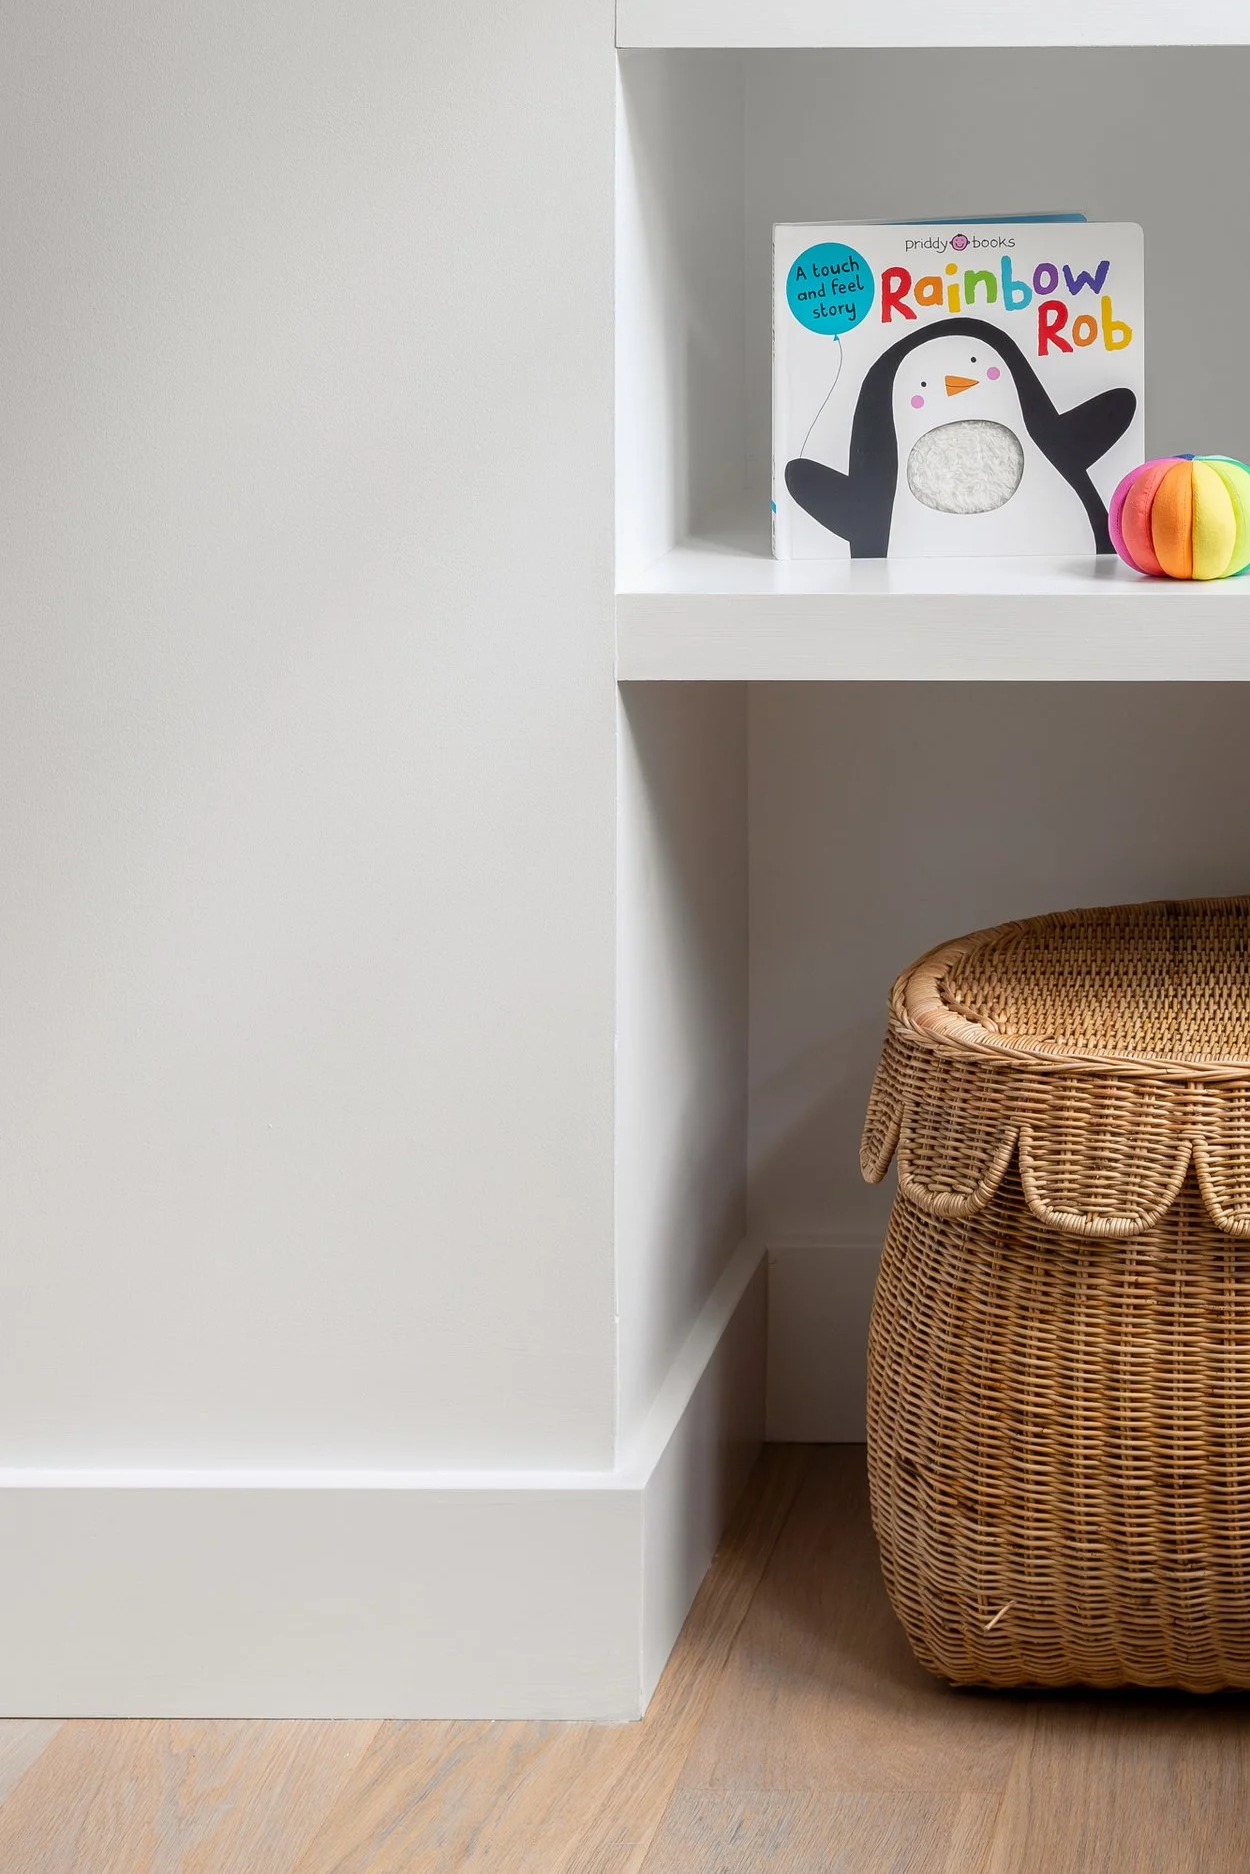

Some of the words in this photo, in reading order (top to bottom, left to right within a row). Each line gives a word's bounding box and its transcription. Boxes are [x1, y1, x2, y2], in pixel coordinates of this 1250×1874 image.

[905, 237, 948, 253] priddy
[972, 236, 1016, 248] books
[796, 266, 807, 281] A
[812, 255, 860, 278] touch
[797, 283, 826, 301] and
[831, 274, 865, 295] feel
[881, 255, 1111, 323] Rainbow
[812, 302, 857, 321] story
[1037, 295, 1133, 357] Rob
